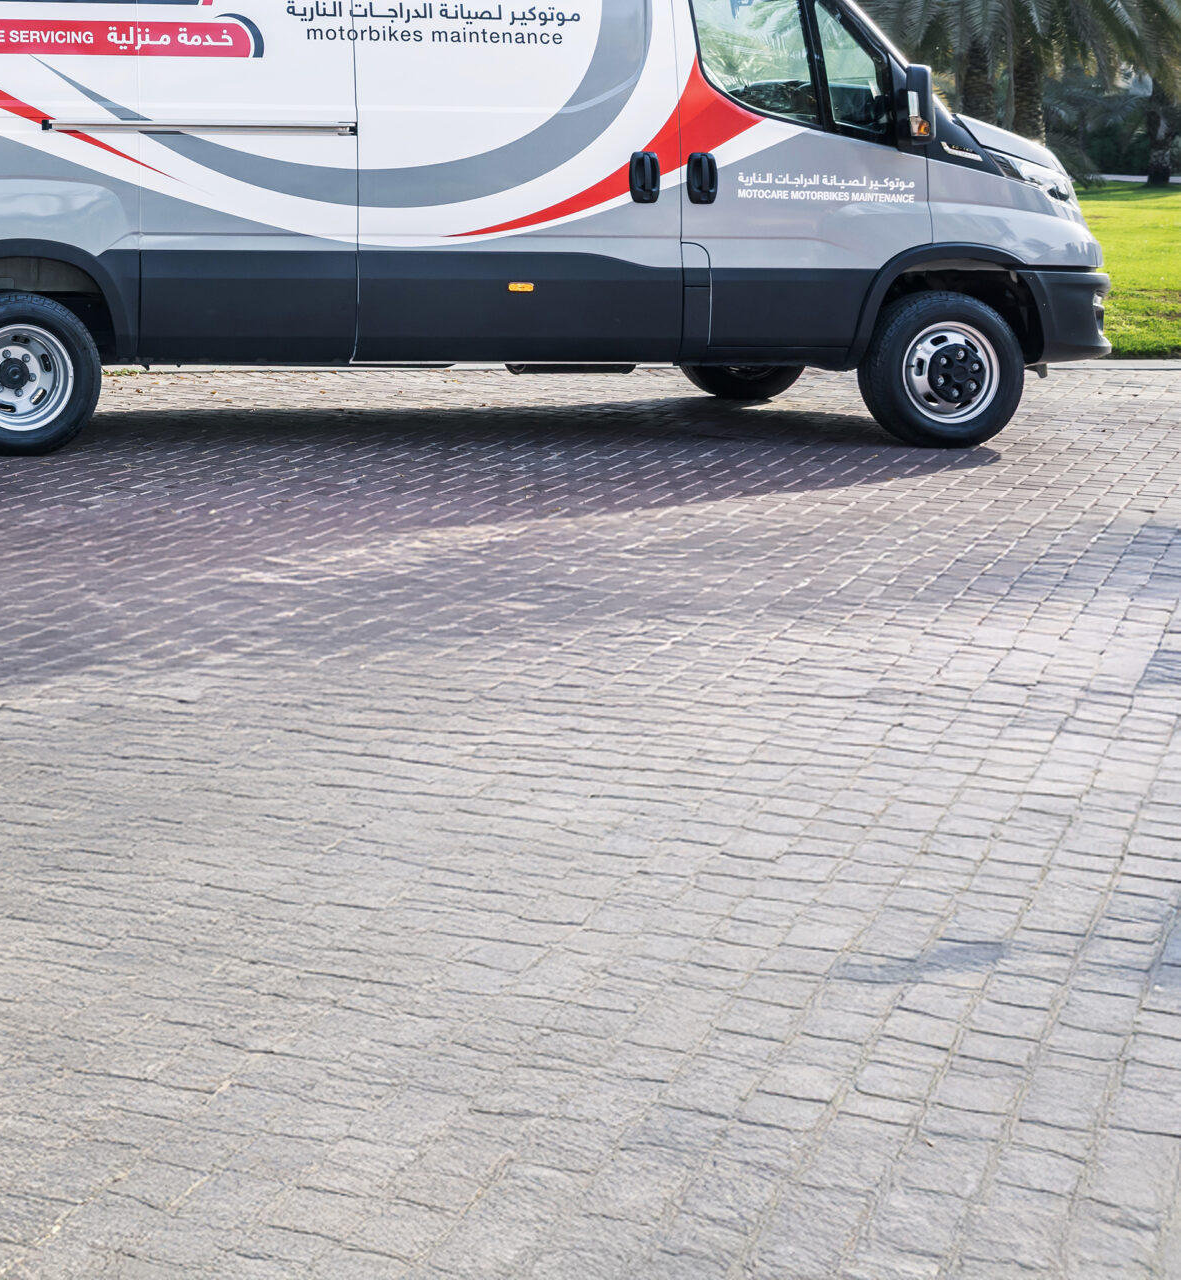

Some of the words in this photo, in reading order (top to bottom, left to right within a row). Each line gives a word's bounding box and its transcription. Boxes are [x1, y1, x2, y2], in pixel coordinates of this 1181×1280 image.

[286, 1, 343, 23] النارية
[350, 3, 433, 24] الدراجات
[439, 4, 503, 25] لصيانة
[509, 6, 581, 27] موتوكير
[9, 30, 94, 45] SERVICING
[106, 26, 171, 50] منزلية
[177, 29, 234, 47] خدمة
[306, 26, 423, 43] motorbikes
[431, 28, 563, 46] maintenance
[737, 172, 773, 186] النارية
[775, 173, 820, 188] الدراجات
[822, 174, 867, 188] لصيانة
[868, 177, 915, 191] موتوكير
[737, 188, 789, 200] MOTOCARE
[791, 190, 850, 202] MOTORBIKES
[851, 191, 915, 204] MAINTENANCE
